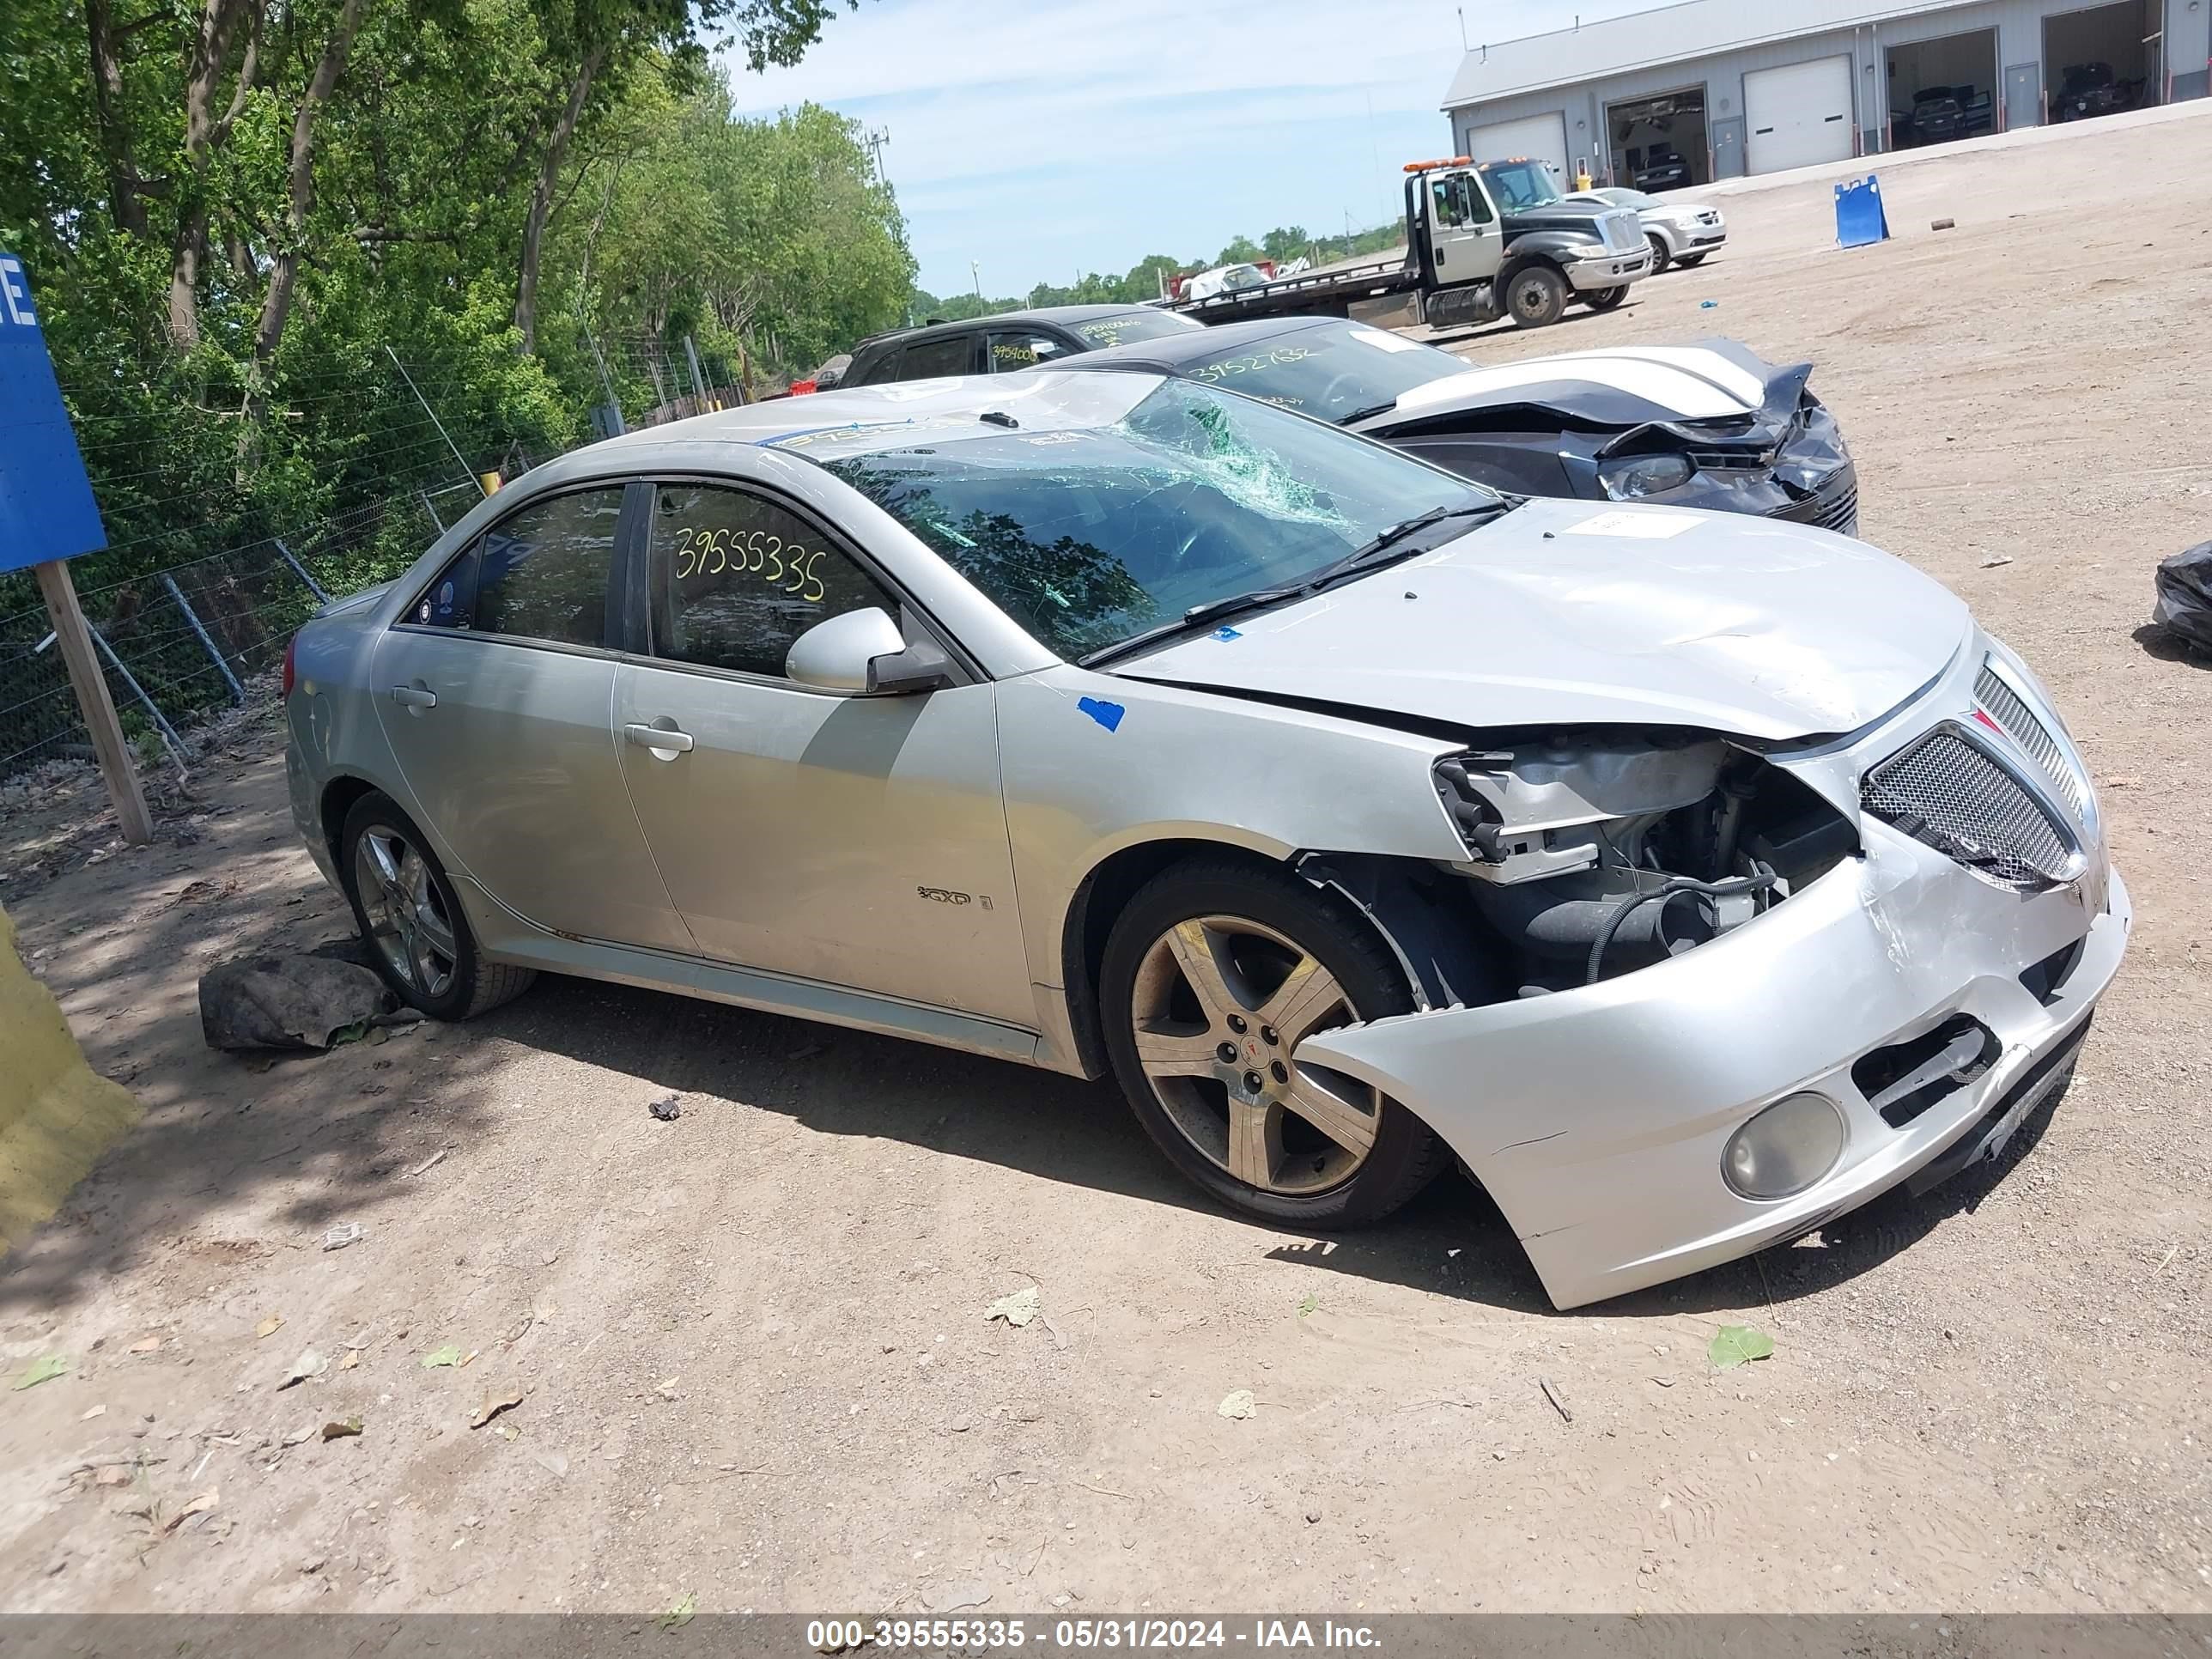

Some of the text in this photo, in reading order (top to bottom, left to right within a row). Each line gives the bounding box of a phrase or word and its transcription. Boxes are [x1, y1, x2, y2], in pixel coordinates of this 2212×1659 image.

[0, 259, 36, 325] E
[1188, 348, 1322, 383] 39527632
[676, 528, 826, 601] 39555335
